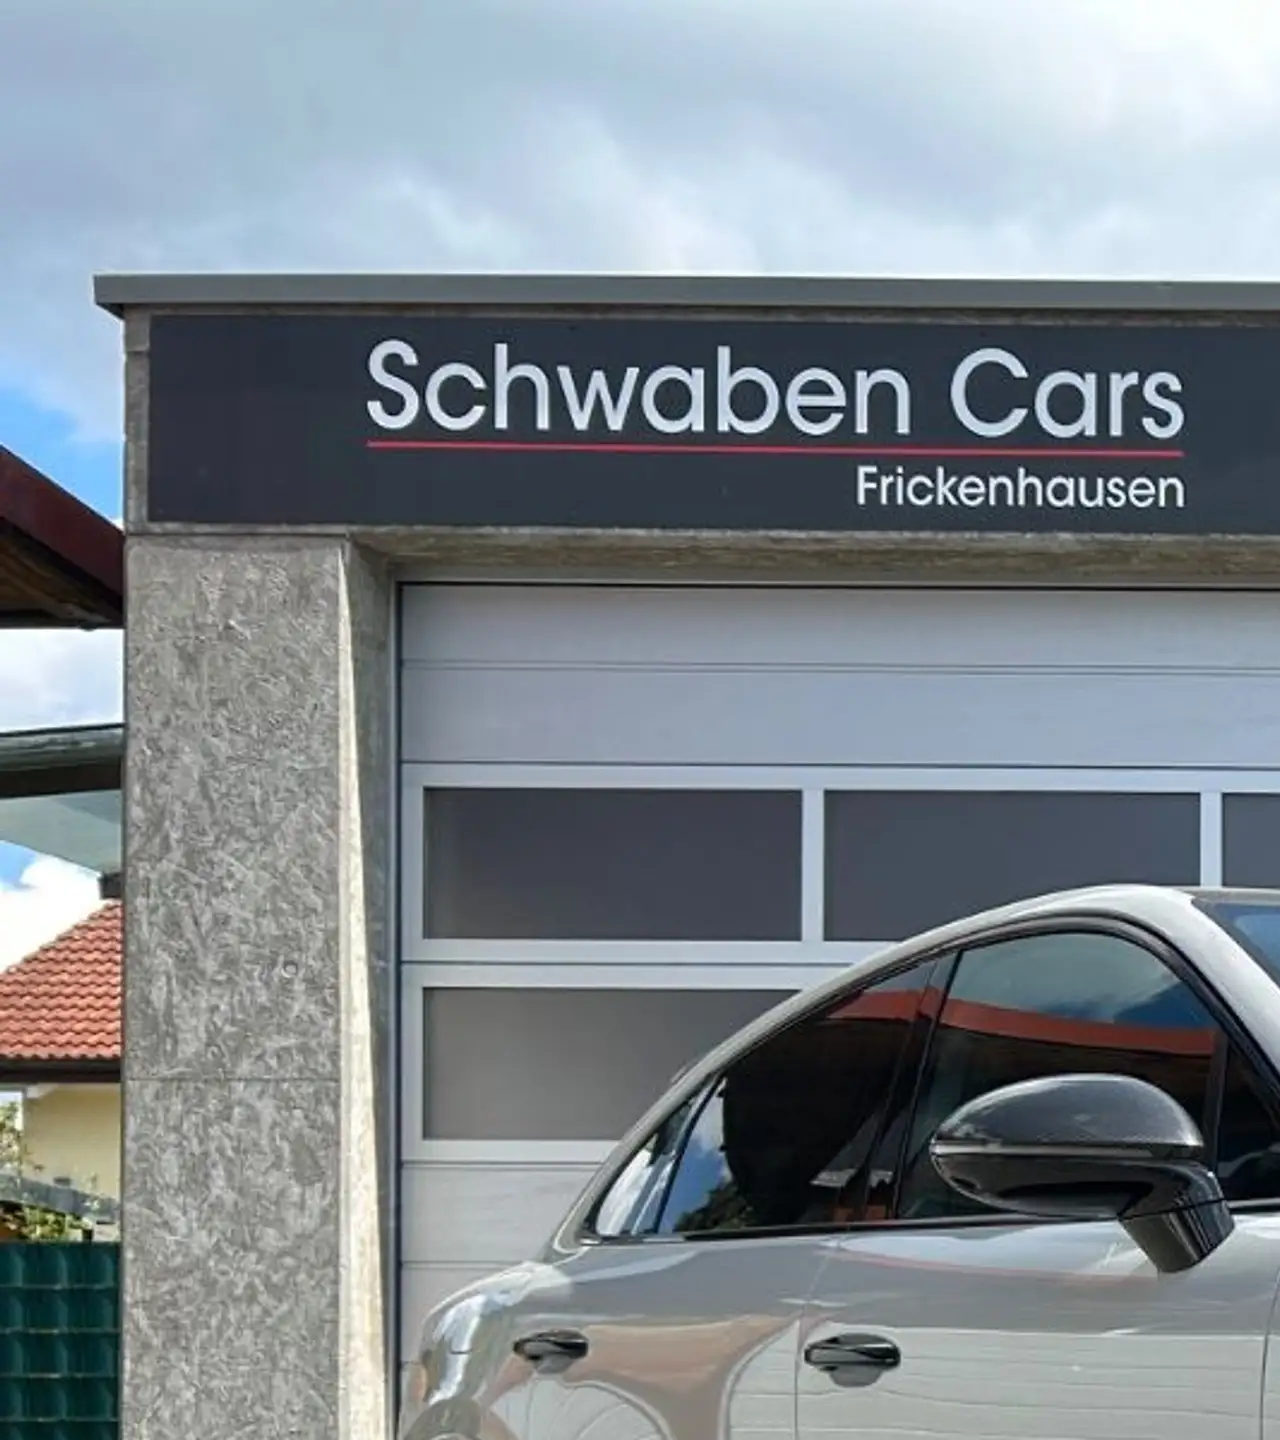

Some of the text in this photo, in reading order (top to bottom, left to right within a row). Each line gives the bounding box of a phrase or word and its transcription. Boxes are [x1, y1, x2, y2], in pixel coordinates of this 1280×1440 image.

[367, 339, 1185, 438] Schwaben Cars
[857, 465, 1185, 508] Frickenhausen
